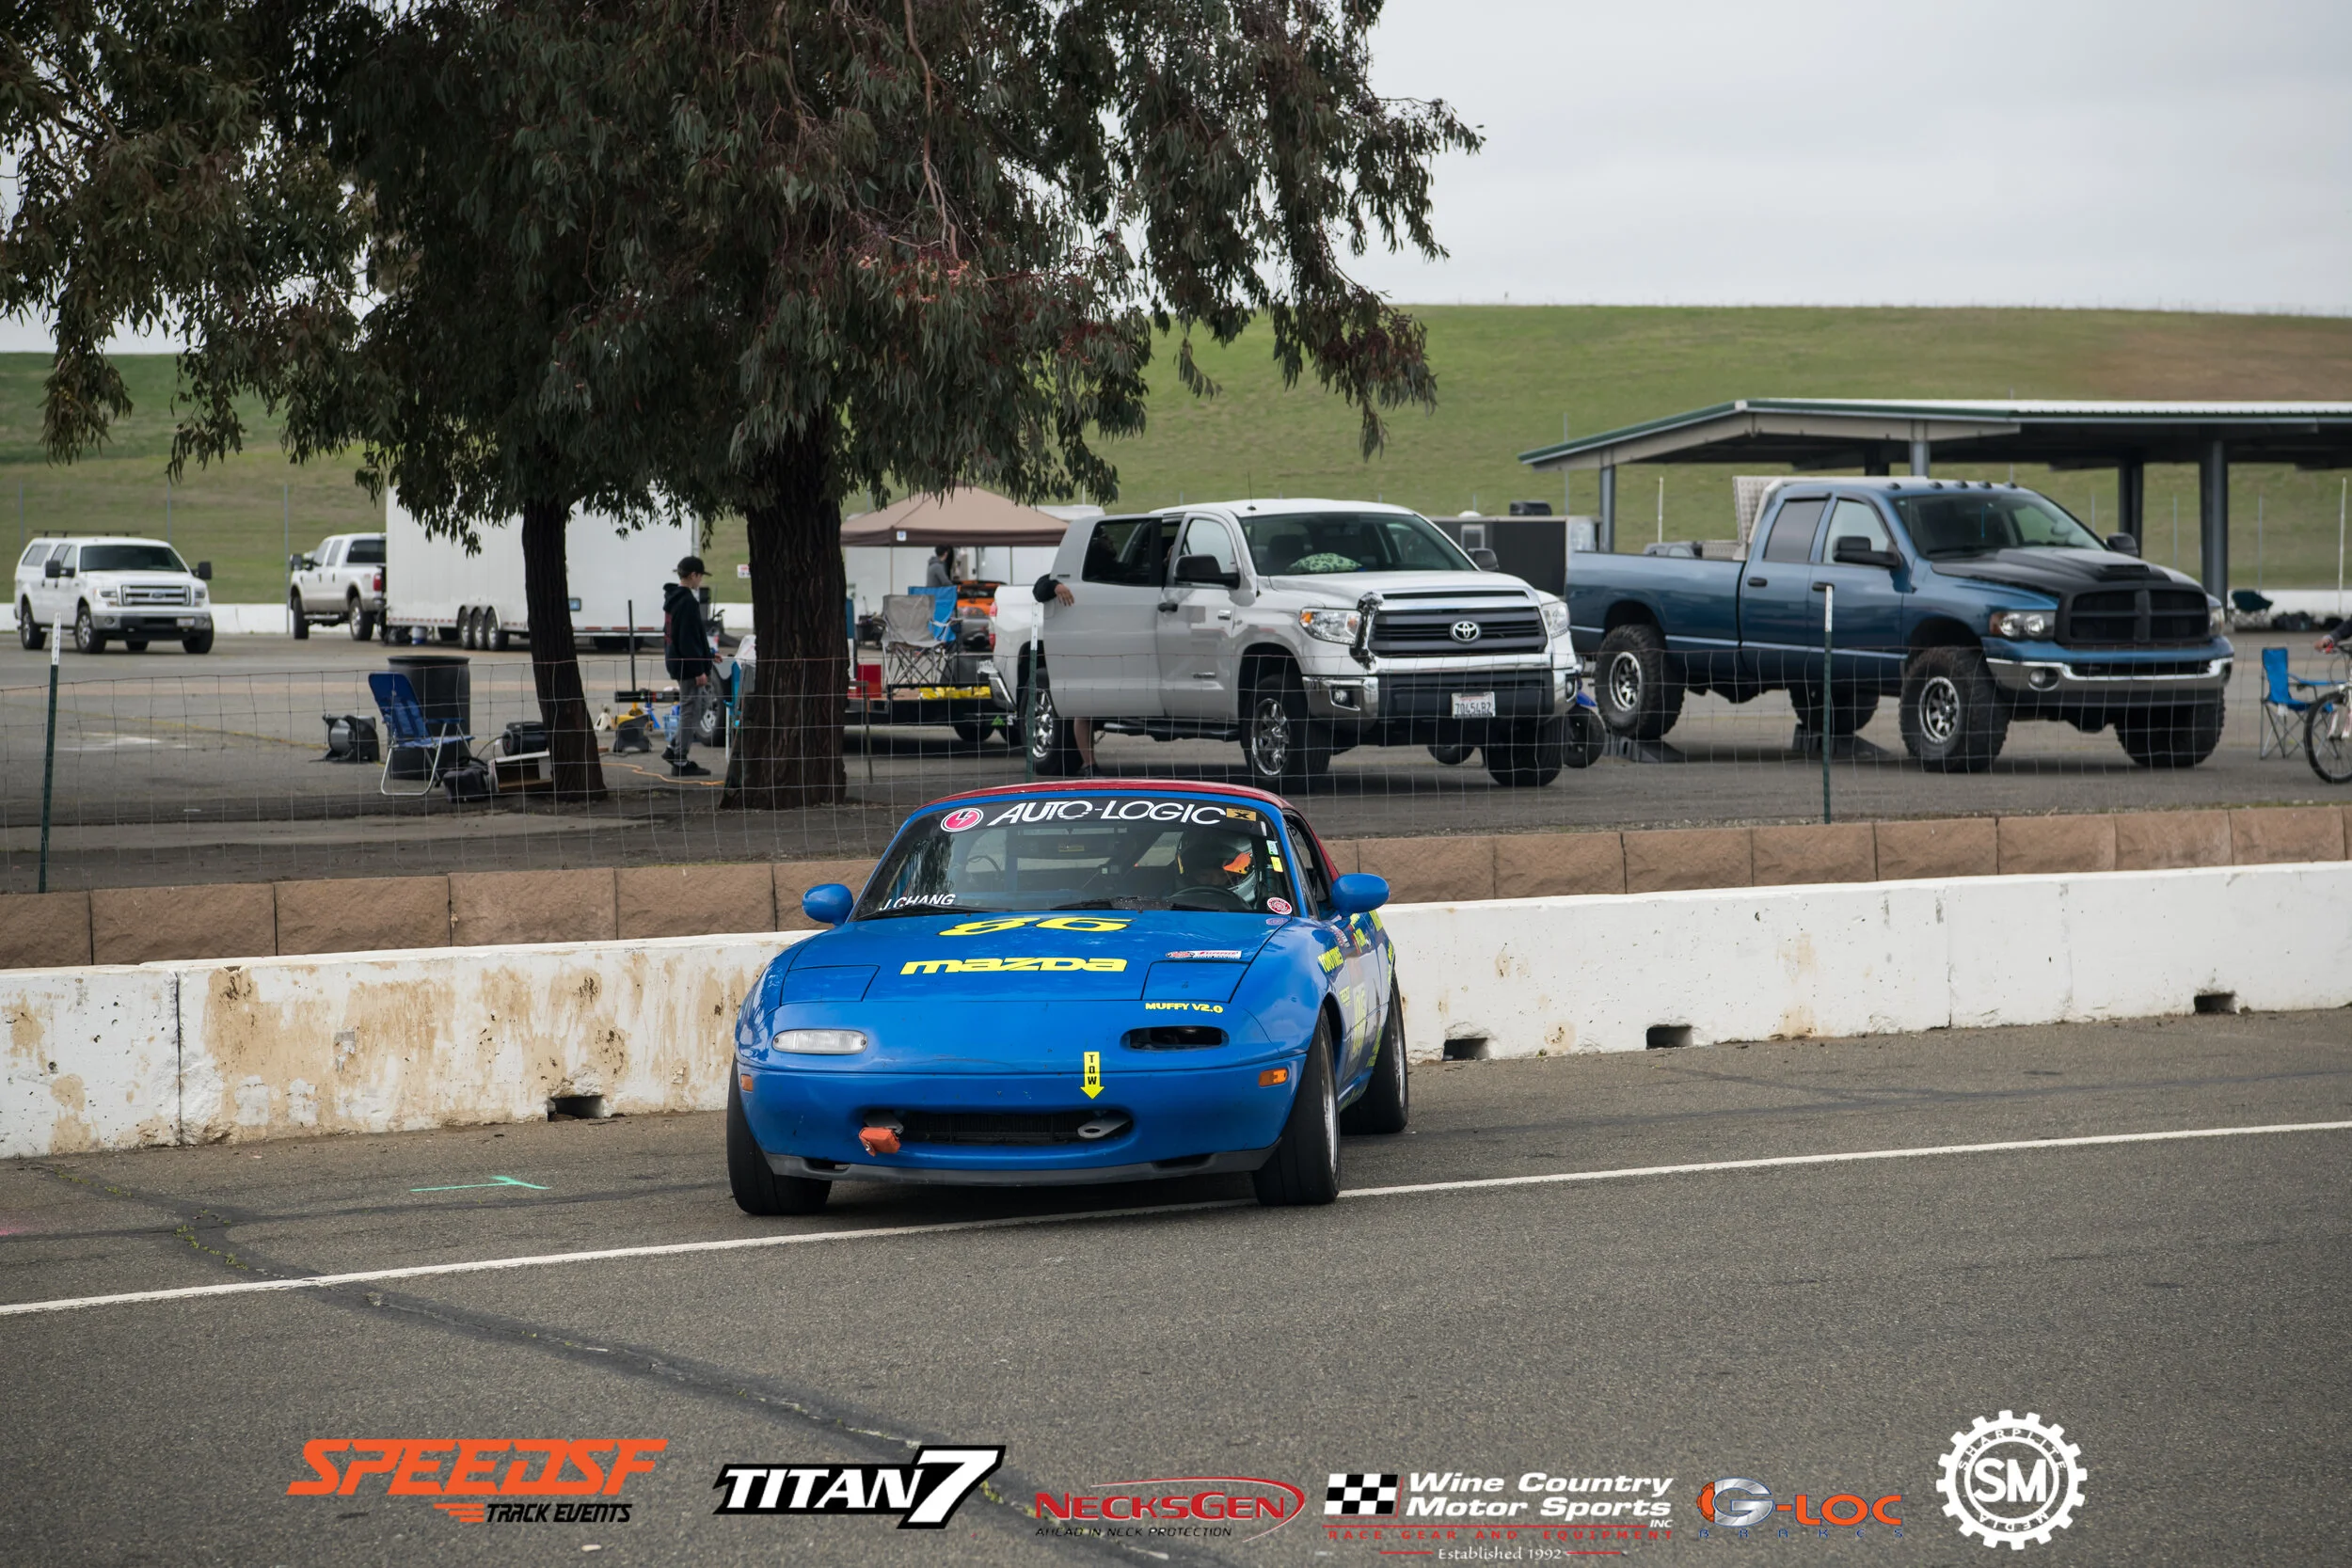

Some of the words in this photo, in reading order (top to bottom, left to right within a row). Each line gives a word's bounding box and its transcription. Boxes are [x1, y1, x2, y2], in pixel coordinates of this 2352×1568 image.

[987, 800, 1226, 827] AUTO-LOGIC
[893, 894, 956, 908] CHANG
[1191, 1003, 1224, 1014] V2.0
[1088, 1054, 1097, 1085] TOW
